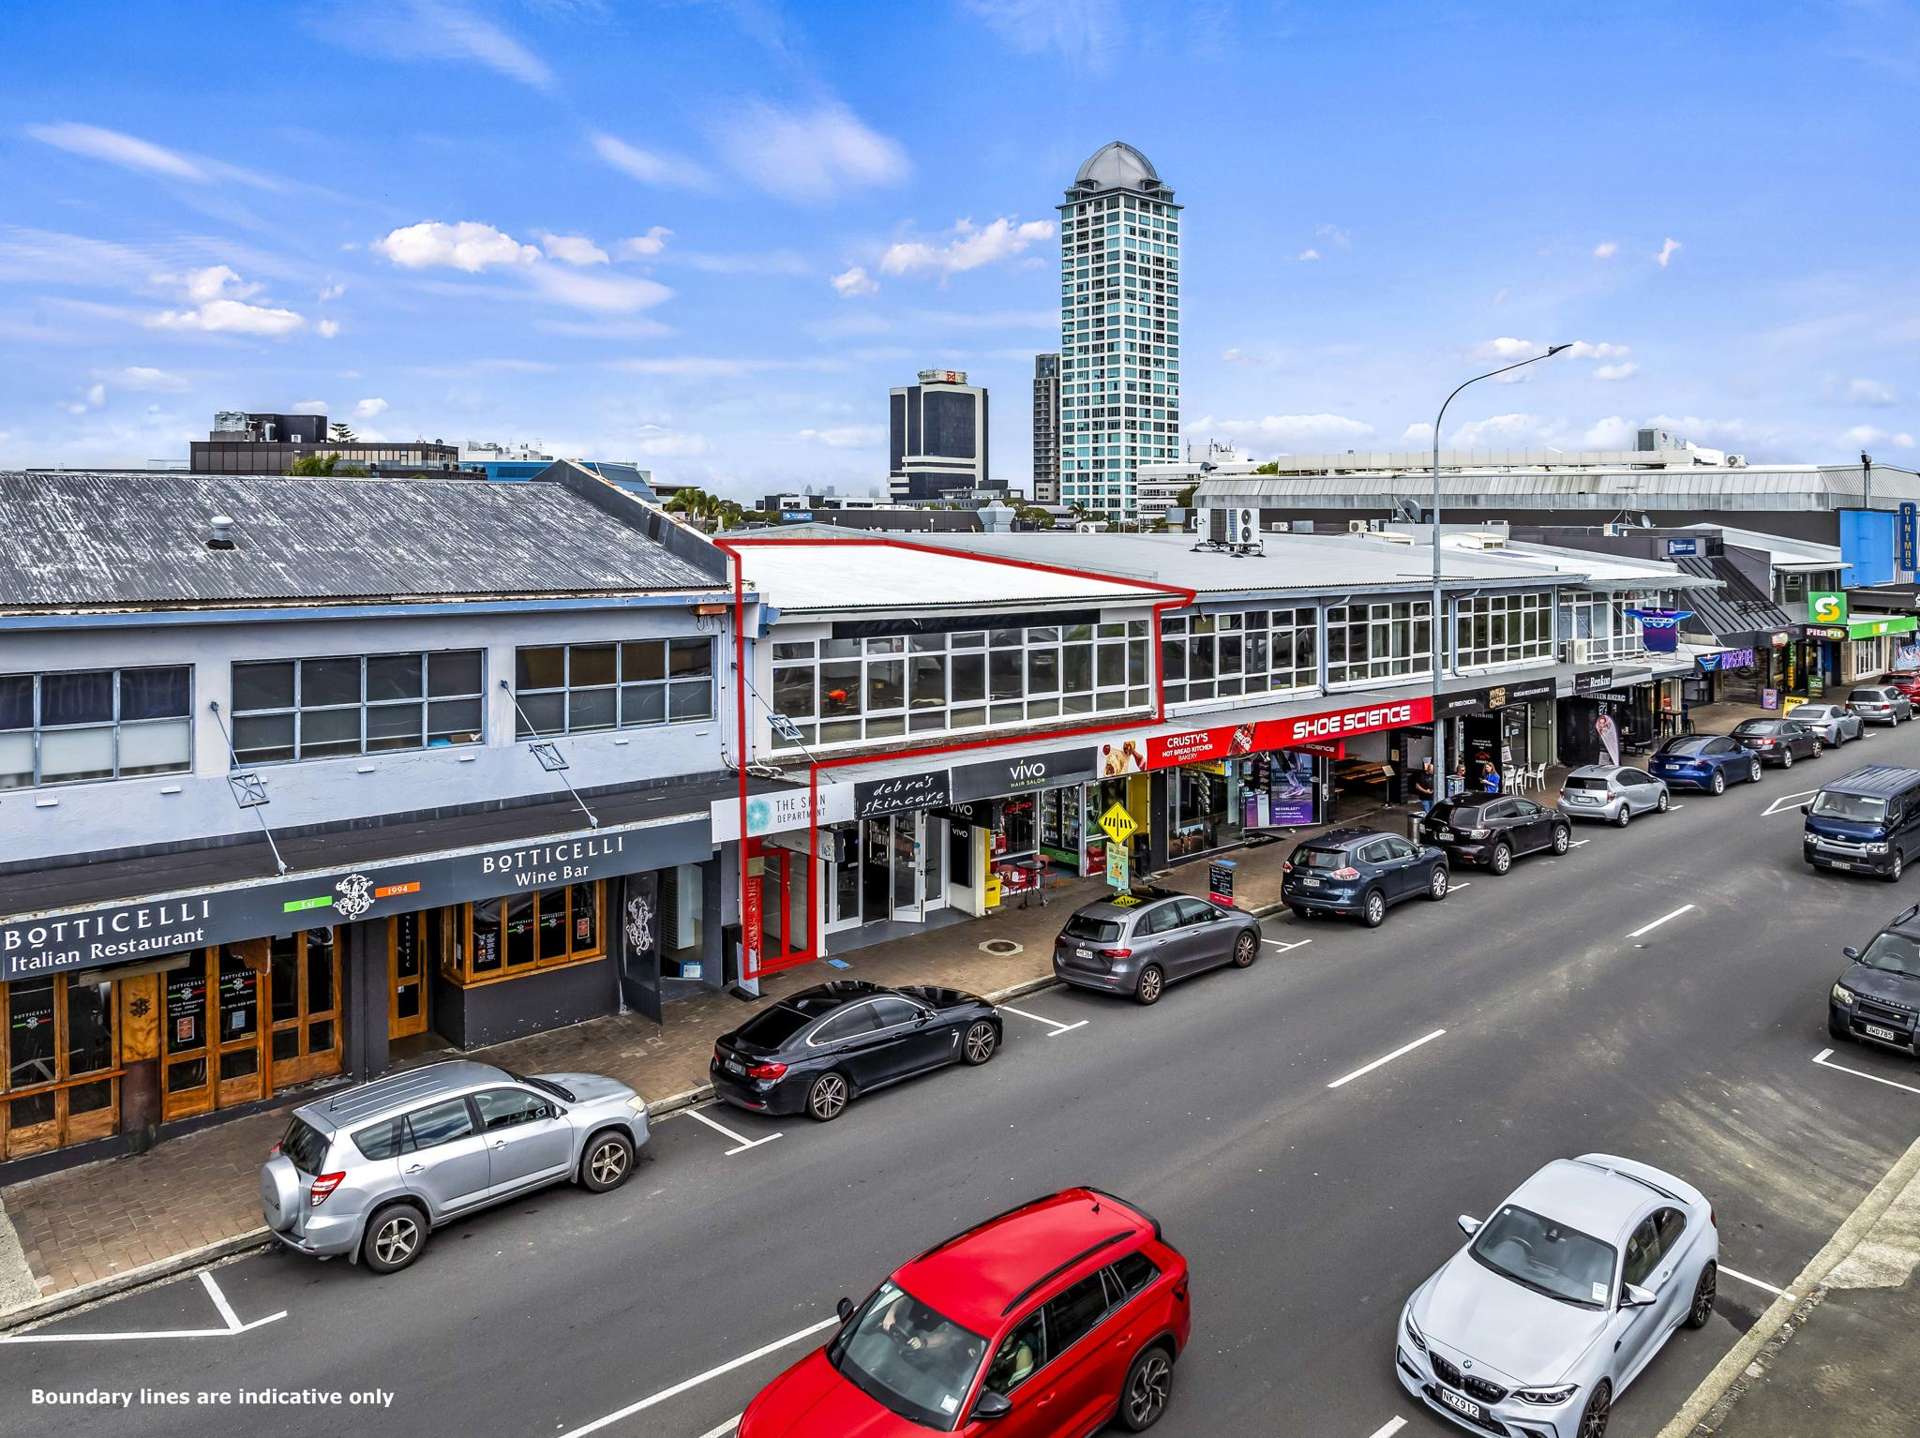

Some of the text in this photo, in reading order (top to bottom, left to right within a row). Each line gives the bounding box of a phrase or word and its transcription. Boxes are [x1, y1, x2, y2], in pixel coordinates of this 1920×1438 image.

[1293, 705, 1411, 740] SHOE SCIENCE
[1167, 732, 1209, 748] CRUSTY'S
[1192, 744, 1213, 752] KITCHEN
[1178, 753, 1198, 761] BAKERY
[873, 775, 934, 796] debra's
[776, 793, 826, 812] THE SN
[861, 791, 945, 815] skincare
[777, 808, 826, 824] DEPARTMNT
[483, 836, 624, 874] BOTTICELLI
[516, 864, 589, 887] Wine Bar
[387, 884, 408, 896] 1994
[3, 899, 210, 950] BOTTICELLI
[11, 927, 205, 973] Italian Restaurant
[1443, 1391, 1479, 1417] NKZ912
